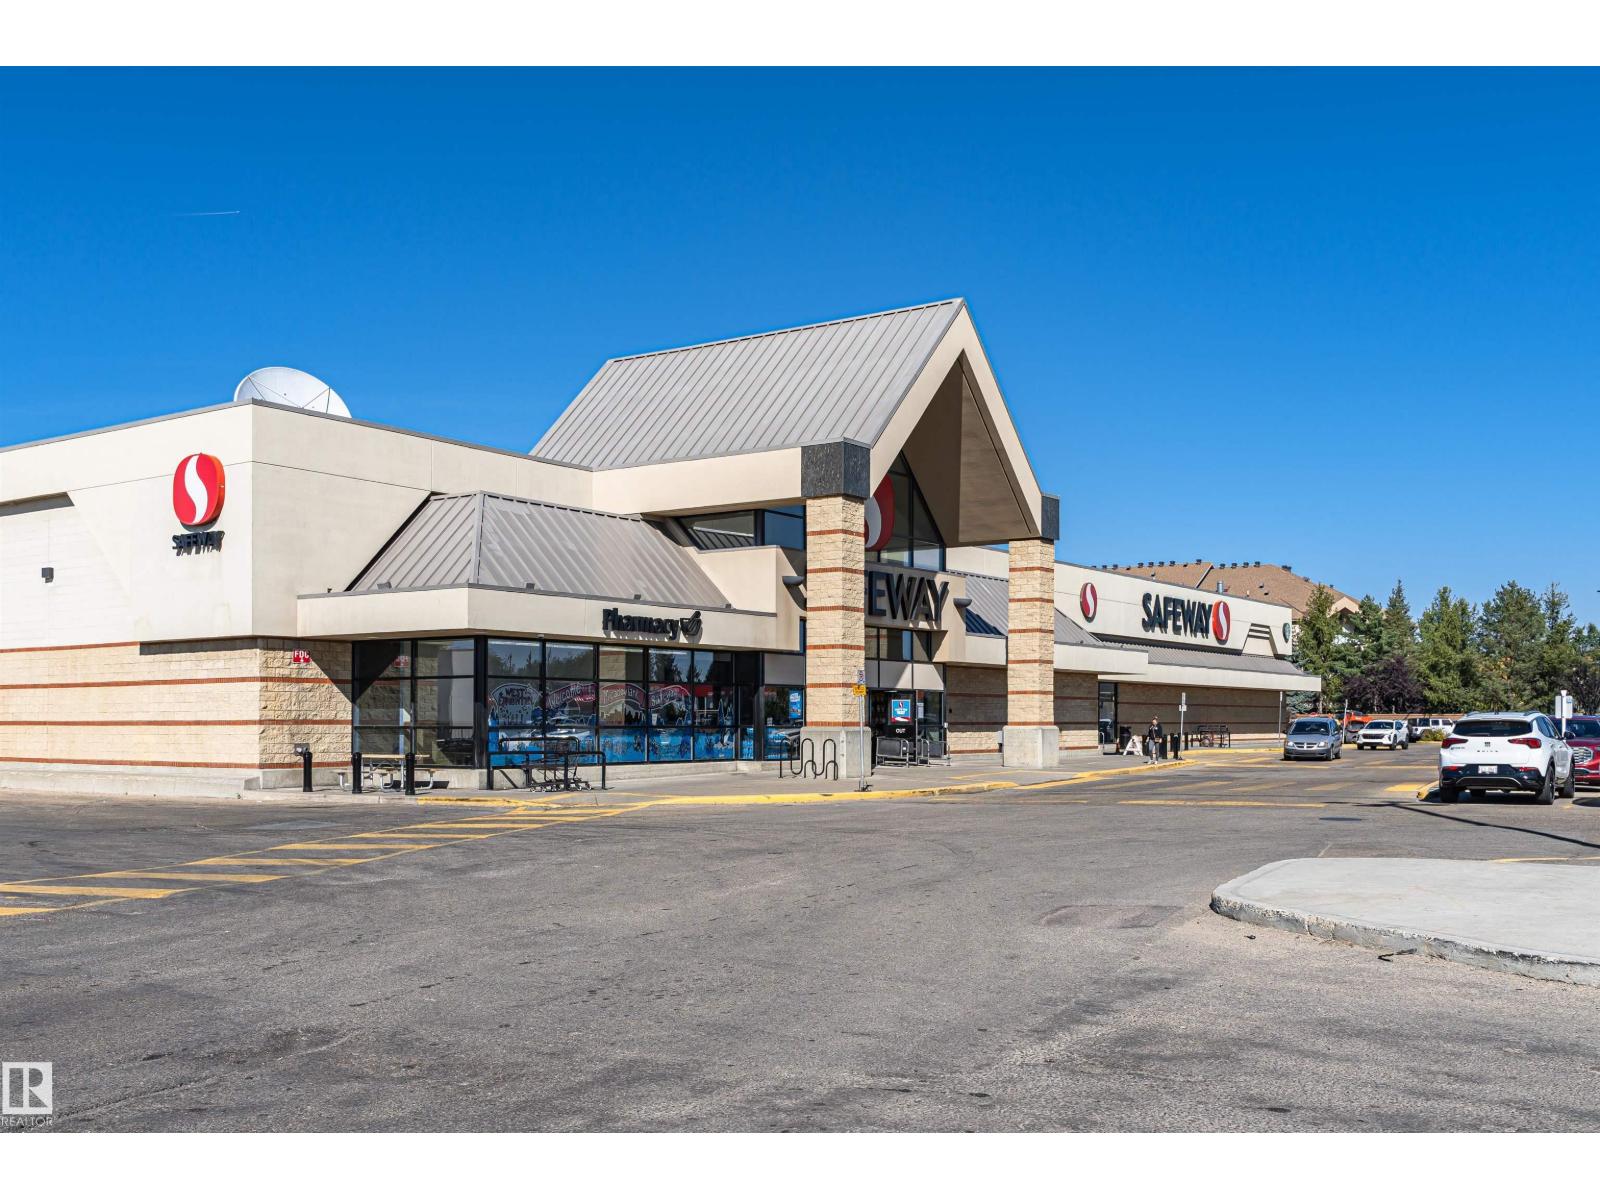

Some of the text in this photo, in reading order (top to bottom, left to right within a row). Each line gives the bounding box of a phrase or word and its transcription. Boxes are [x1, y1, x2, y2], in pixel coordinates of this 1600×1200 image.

[172, 531, 225, 551] SAFEWAY
[865, 570, 949, 622] EWAY
[1142, 592, 1212, 638] SAFEWAY
[602, 608, 679, 640] Pharmacy
